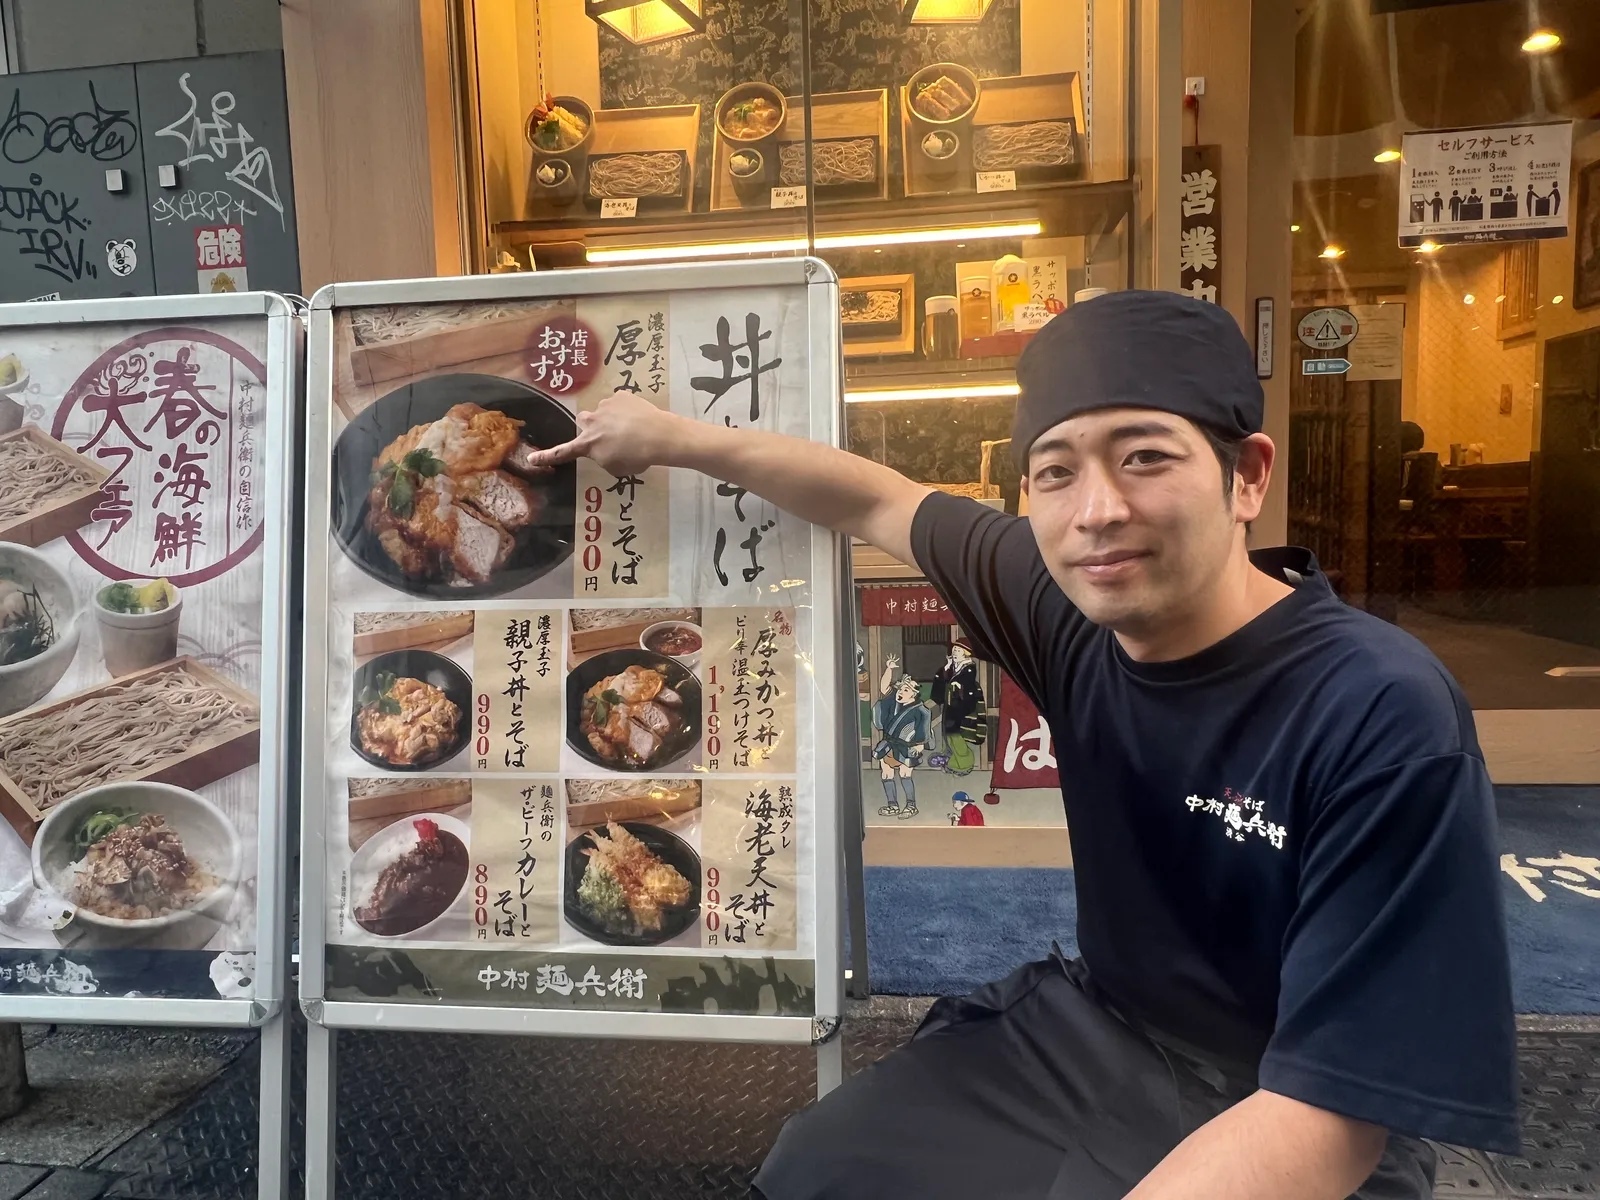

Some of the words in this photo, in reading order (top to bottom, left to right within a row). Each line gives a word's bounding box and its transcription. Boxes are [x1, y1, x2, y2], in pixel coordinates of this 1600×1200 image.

[1437, 133, 1535, 152] セルフサービス
[1448, 166, 1456, 175] 2
[1463, 150, 1508, 161] ご利用方法
[1489, 163, 1496, 172] 3
[197, 228, 243, 266] 危険
[1032, 265, 1043, 305] 黒ラベ
[1046, 260, 1057, 299] サッポ
[530, 326, 574, 392] おすすめ
[570, 328, 589, 366] 店長
[646, 312, 665, 394] 濃厚玉子
[77, 377, 153, 552] 大フェア
[143, 346, 229, 570] 春の海鮮
[604, 319, 648, 585] 厚み丼とそば
[690, 312, 783, 587] 丼ば
[582, 486, 603, 592] 990円
[536, 614, 552, 677] 濃厚玉子
[771, 609, 793, 636] 名物
[502, 619, 533, 769] 親子丼とそば
[706, 665, 725, 770] 1,190円
[751, 628, 780, 761] 厚みかつ丼と
[476, 693, 491, 769] 990円
[539, 784, 554, 842] 麺兵衛の
[777, 786, 794, 849] 熟成タレ
[1243, 796, 1265, 812] そば
[514, 785, 537, 938] ザ・ビーフカレーと
[743, 788, 778, 938] 海老天丼と
[474, 863, 489, 940] 890円
[493, 889, 518, 938] そば
[706, 867, 721, 946] 990円
[724, 893, 750, 944] そば
[477, 963, 649, 1000] 中村麺兵衛
